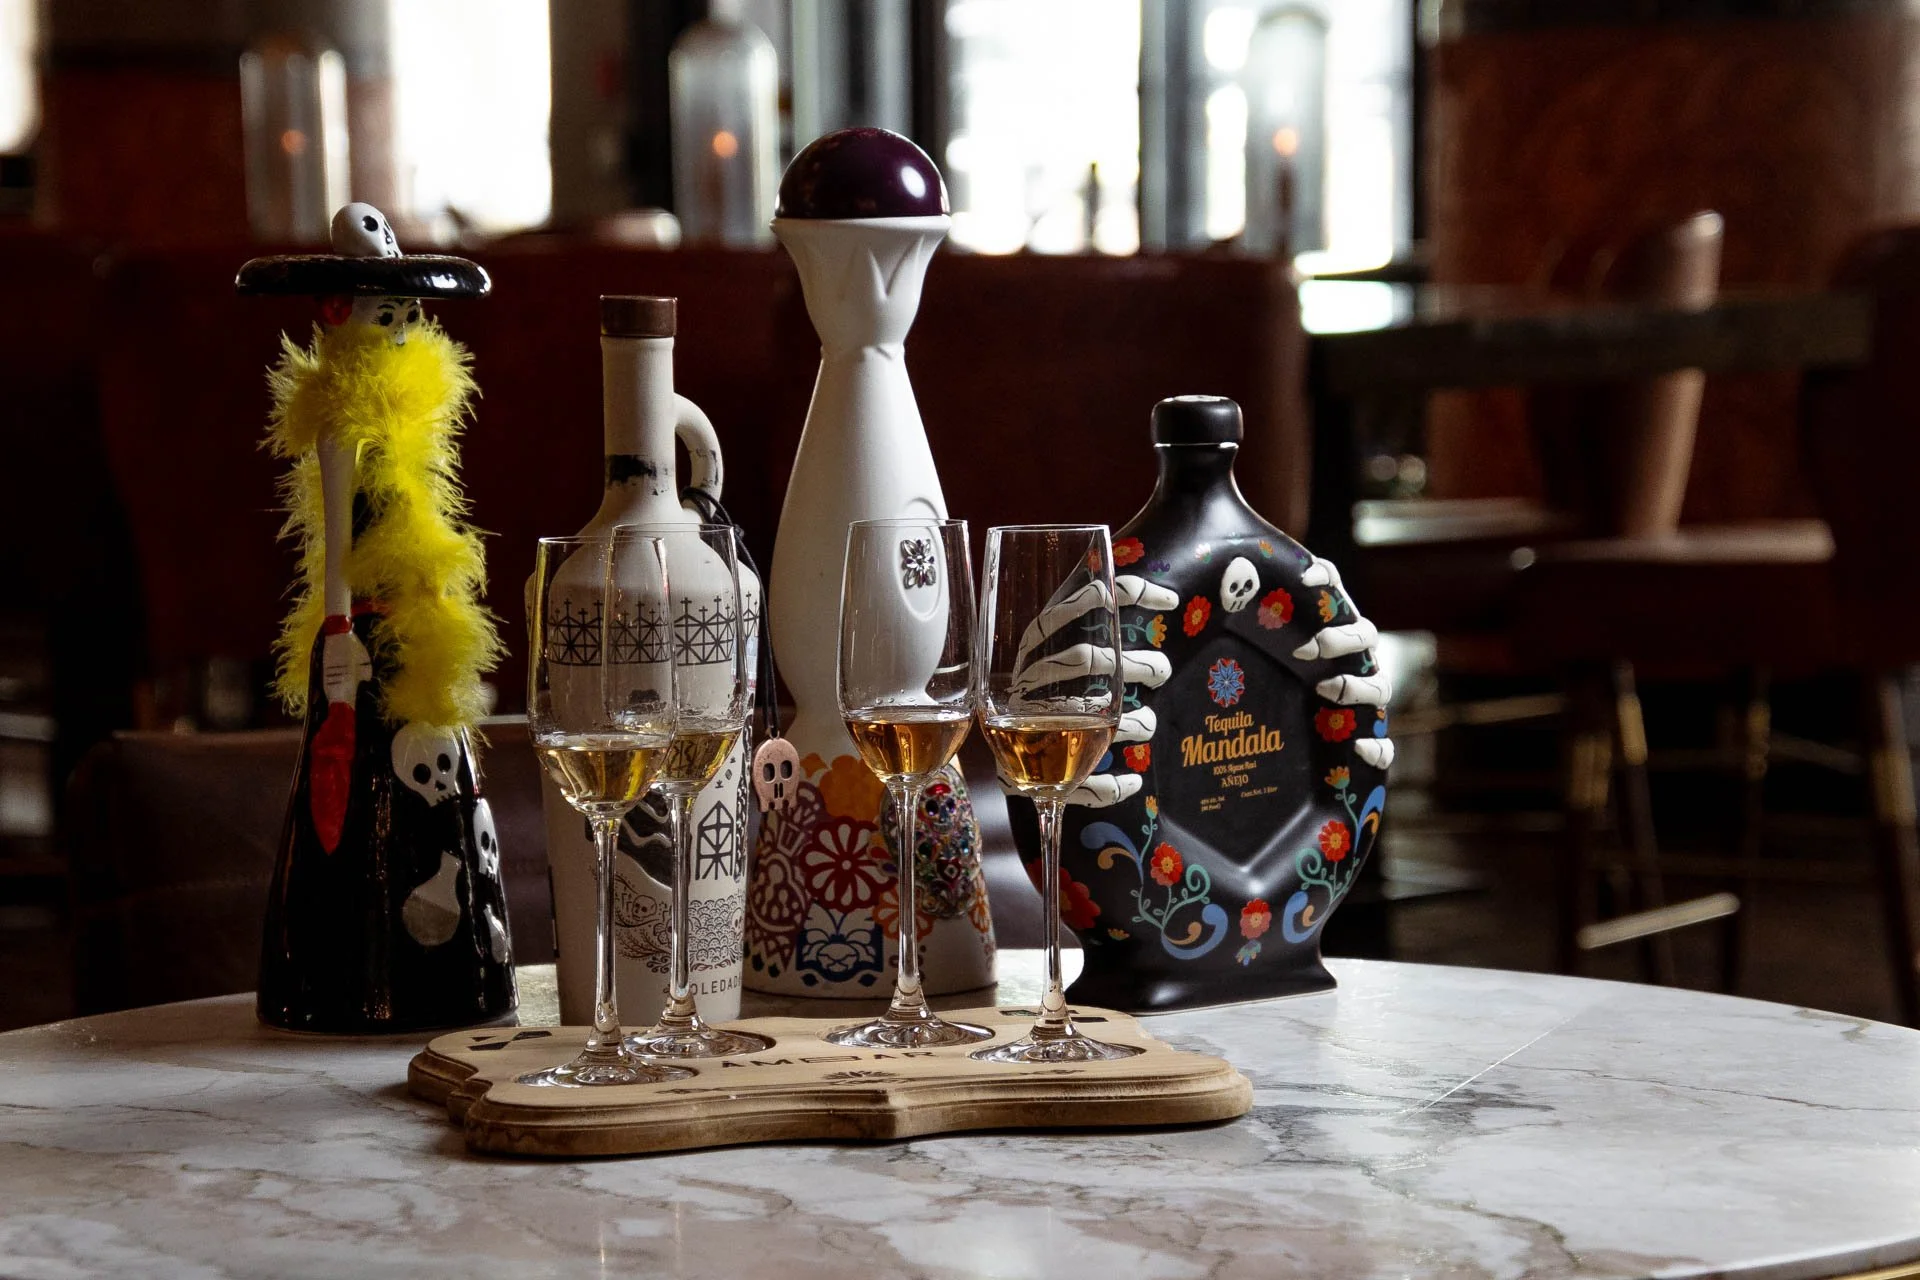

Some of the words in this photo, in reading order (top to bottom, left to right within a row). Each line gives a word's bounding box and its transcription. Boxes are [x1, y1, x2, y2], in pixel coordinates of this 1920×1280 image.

[1205, 711, 1255, 736] Tequila
[1181, 725, 1285, 767] Mandala
[1221, 774, 1249, 788] AÑEJO
